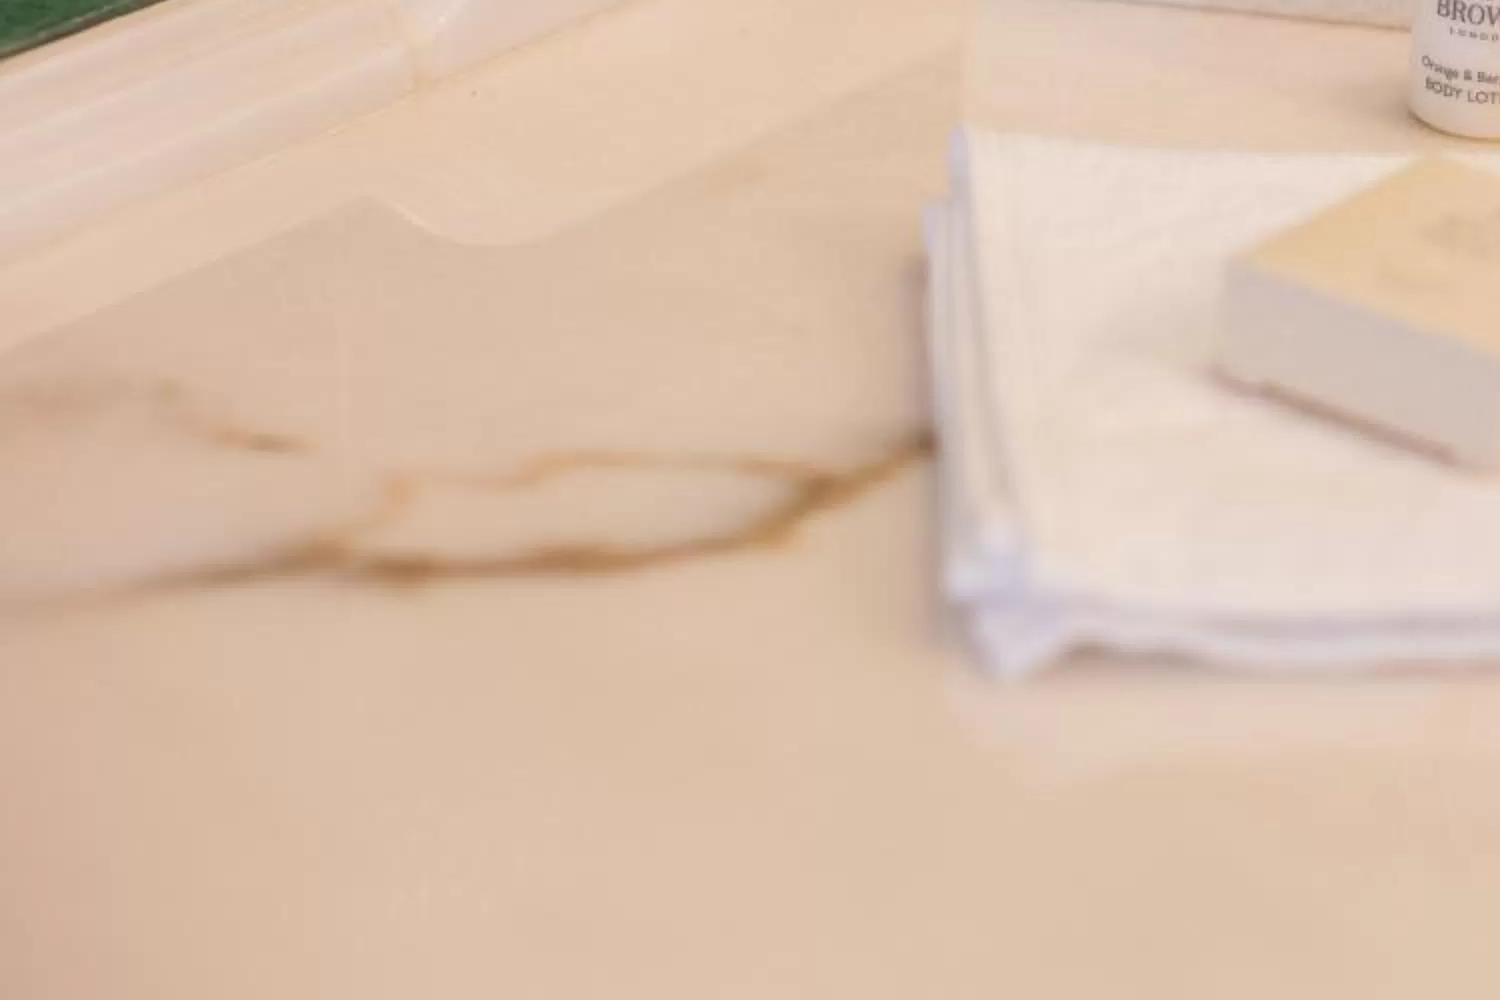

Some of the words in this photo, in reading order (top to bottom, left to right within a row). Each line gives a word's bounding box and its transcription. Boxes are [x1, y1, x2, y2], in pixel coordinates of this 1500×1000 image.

[1421, 55, 1459, 82] Orange
[1463, 68, 1473, 81] &
[1425, 76, 1463, 99] BODY
